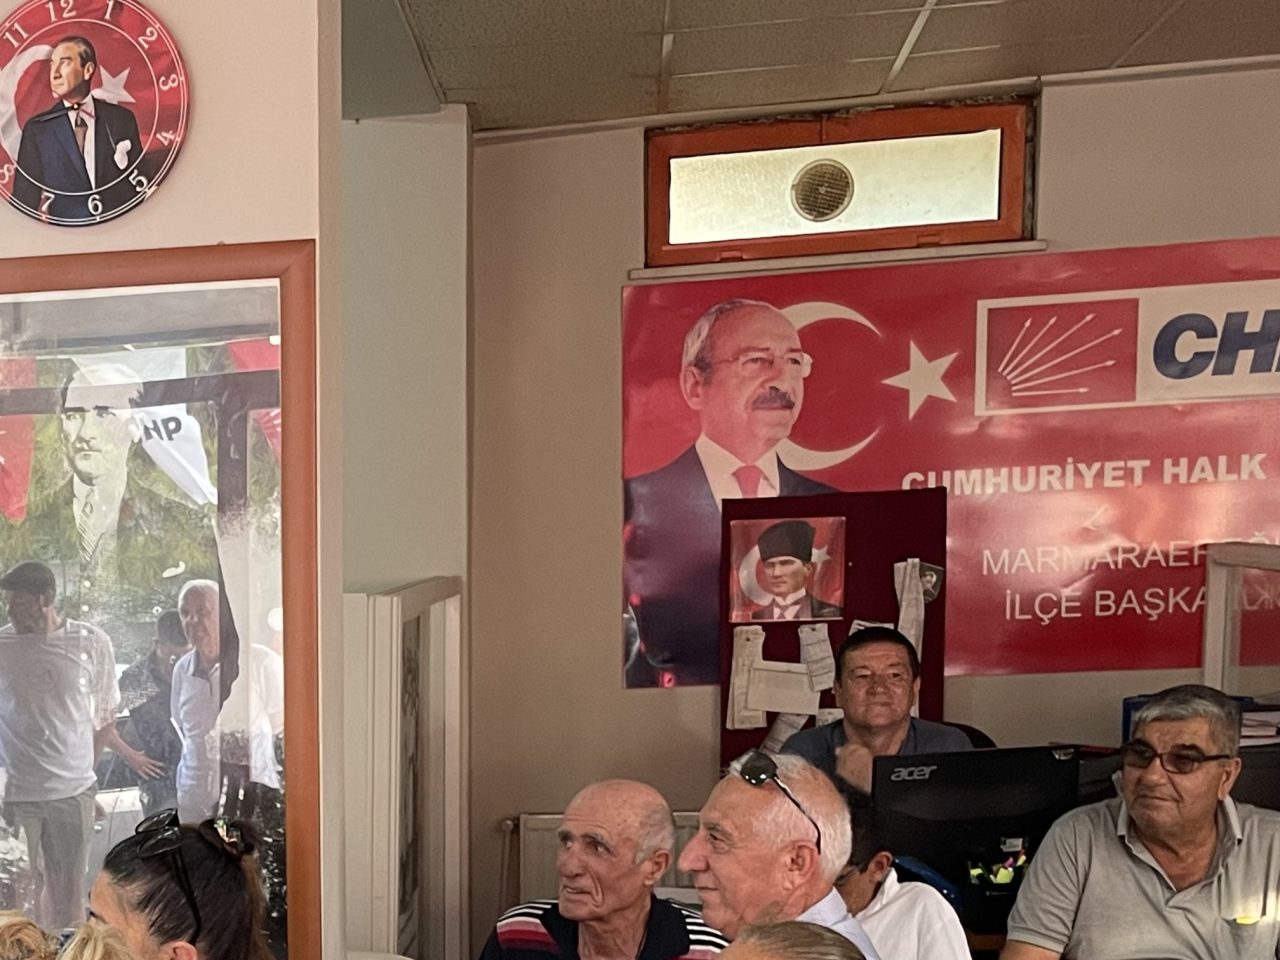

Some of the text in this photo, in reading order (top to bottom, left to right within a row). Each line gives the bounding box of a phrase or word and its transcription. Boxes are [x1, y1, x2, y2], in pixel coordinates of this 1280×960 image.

[3, 22, 29, 48] 11
[138, 26, 158, 49] 2
[159, 73, 179, 91] 3
[156, 130, 176, 146] 4
[128, 168, 148, 192] 5
[40, 191, 55, 212] 7
[87, 194, 103, 215] 6
[1152, 309, 1280, 380] CH
[902, 452, 1268, 495] CUMHURİYET HALK
[1005, 589, 1082, 625] İLÇE
[890, 765, 938, 781] acer
